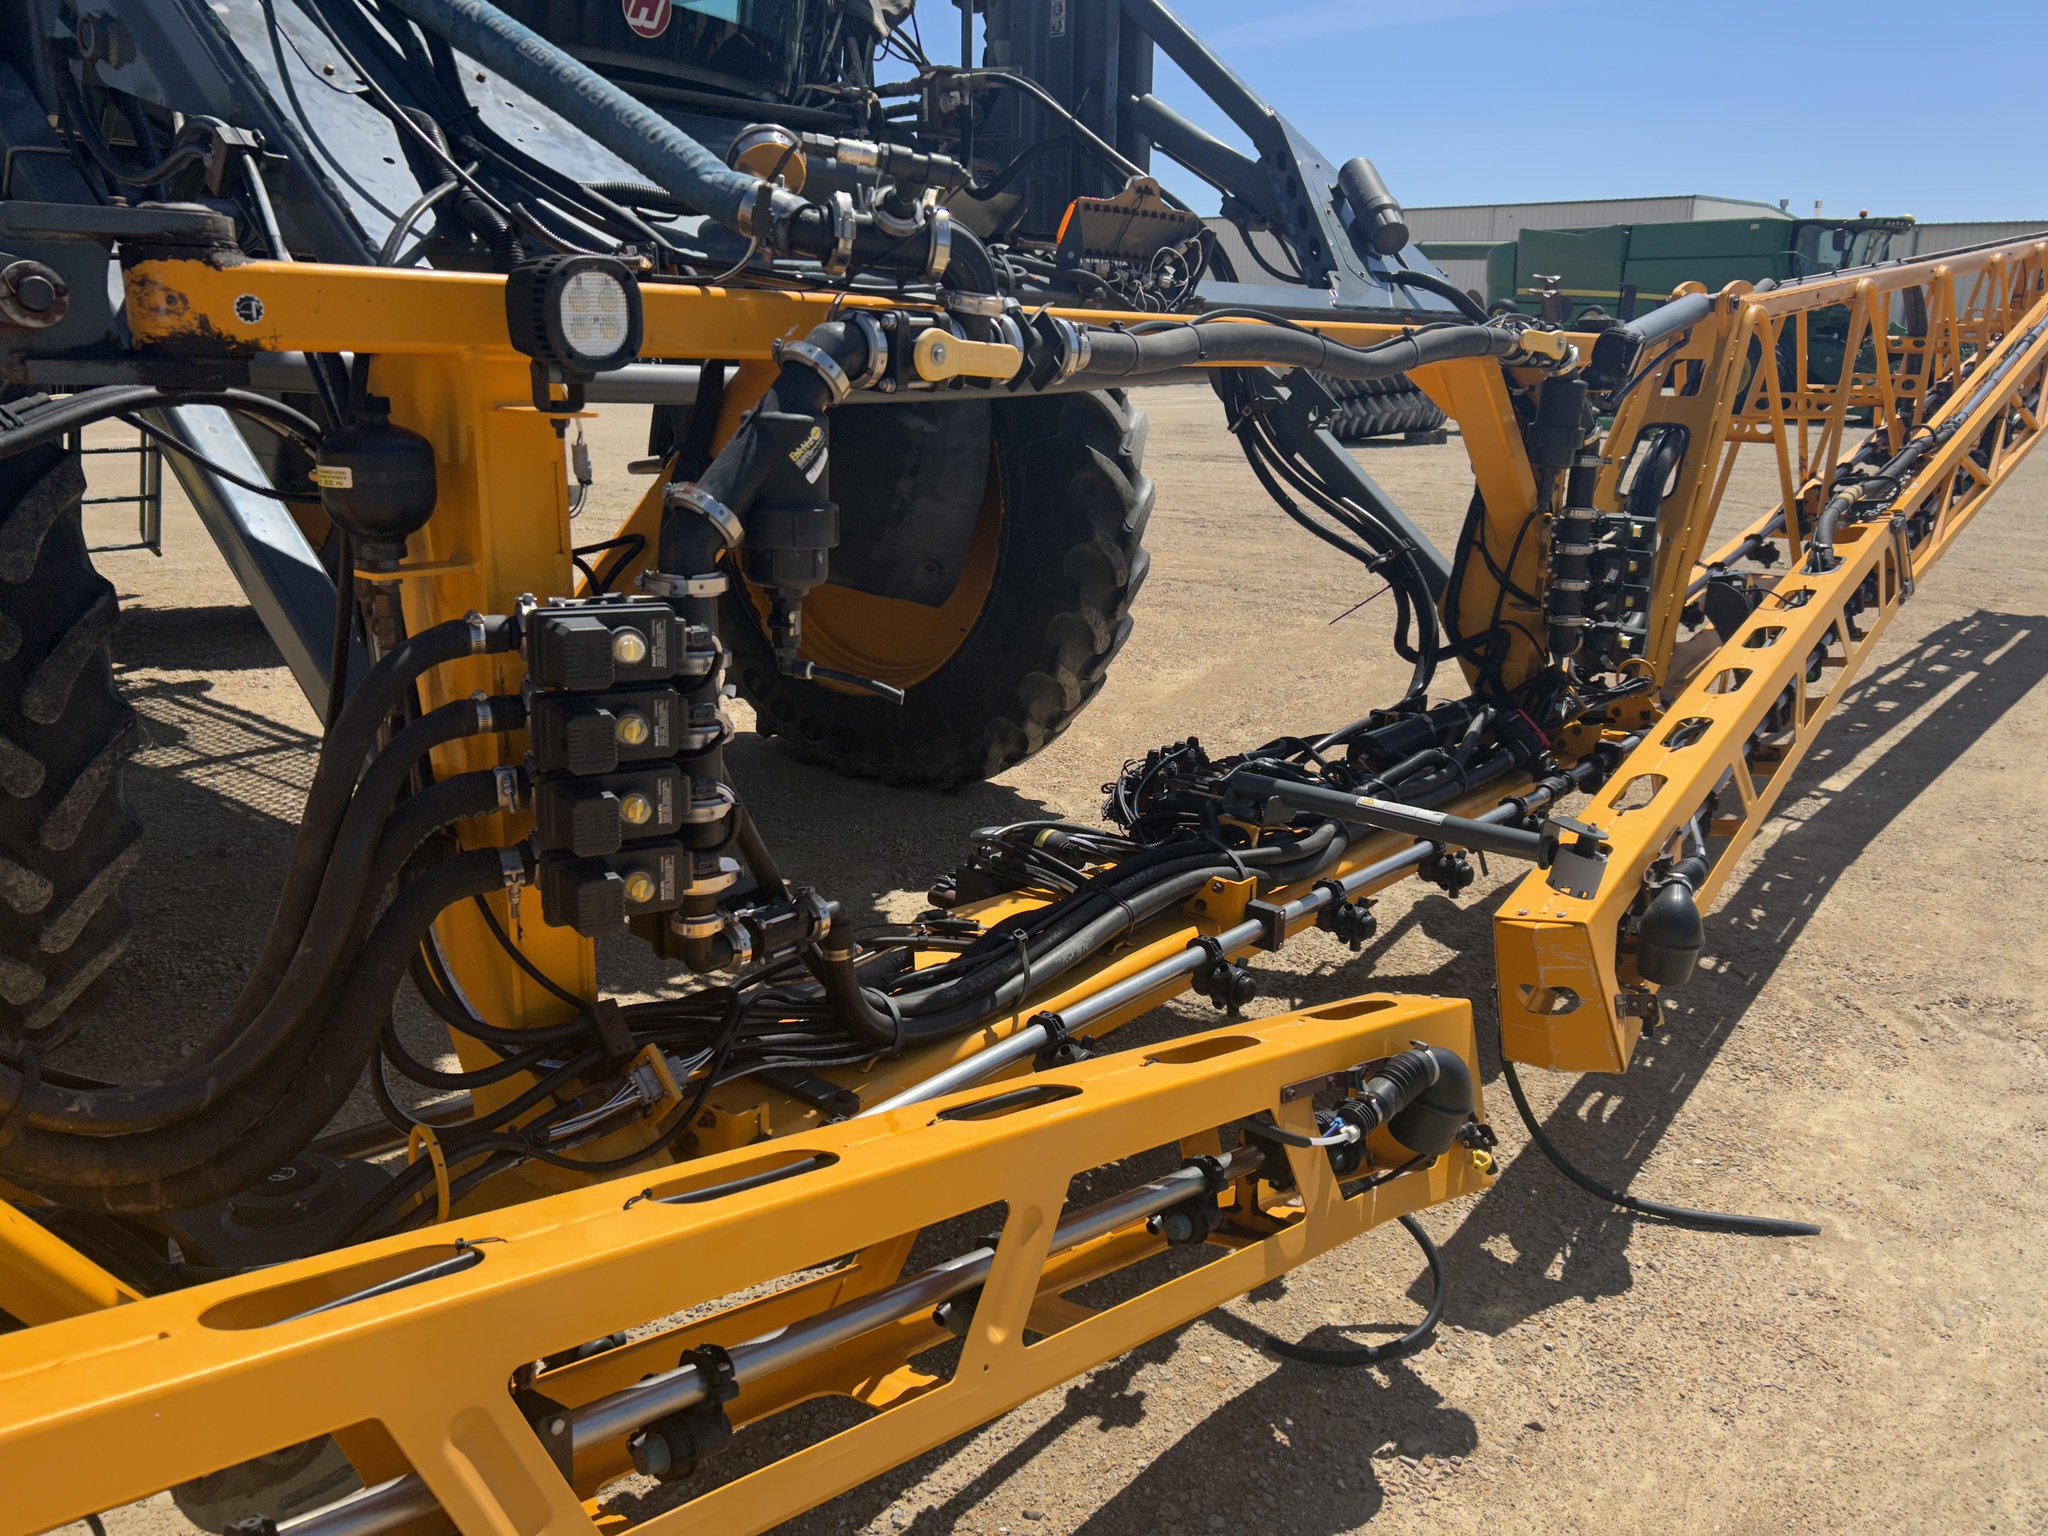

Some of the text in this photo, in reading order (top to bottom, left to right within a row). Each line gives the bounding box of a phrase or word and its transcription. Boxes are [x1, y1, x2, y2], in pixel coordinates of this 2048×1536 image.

[485, 17, 520, 41] ITALY
[518, 39, 554, 64] 505
[549, 61, 580, 83] 16
[575, 76, 617, 109] bar
[615, 105, 667, 145] (240
